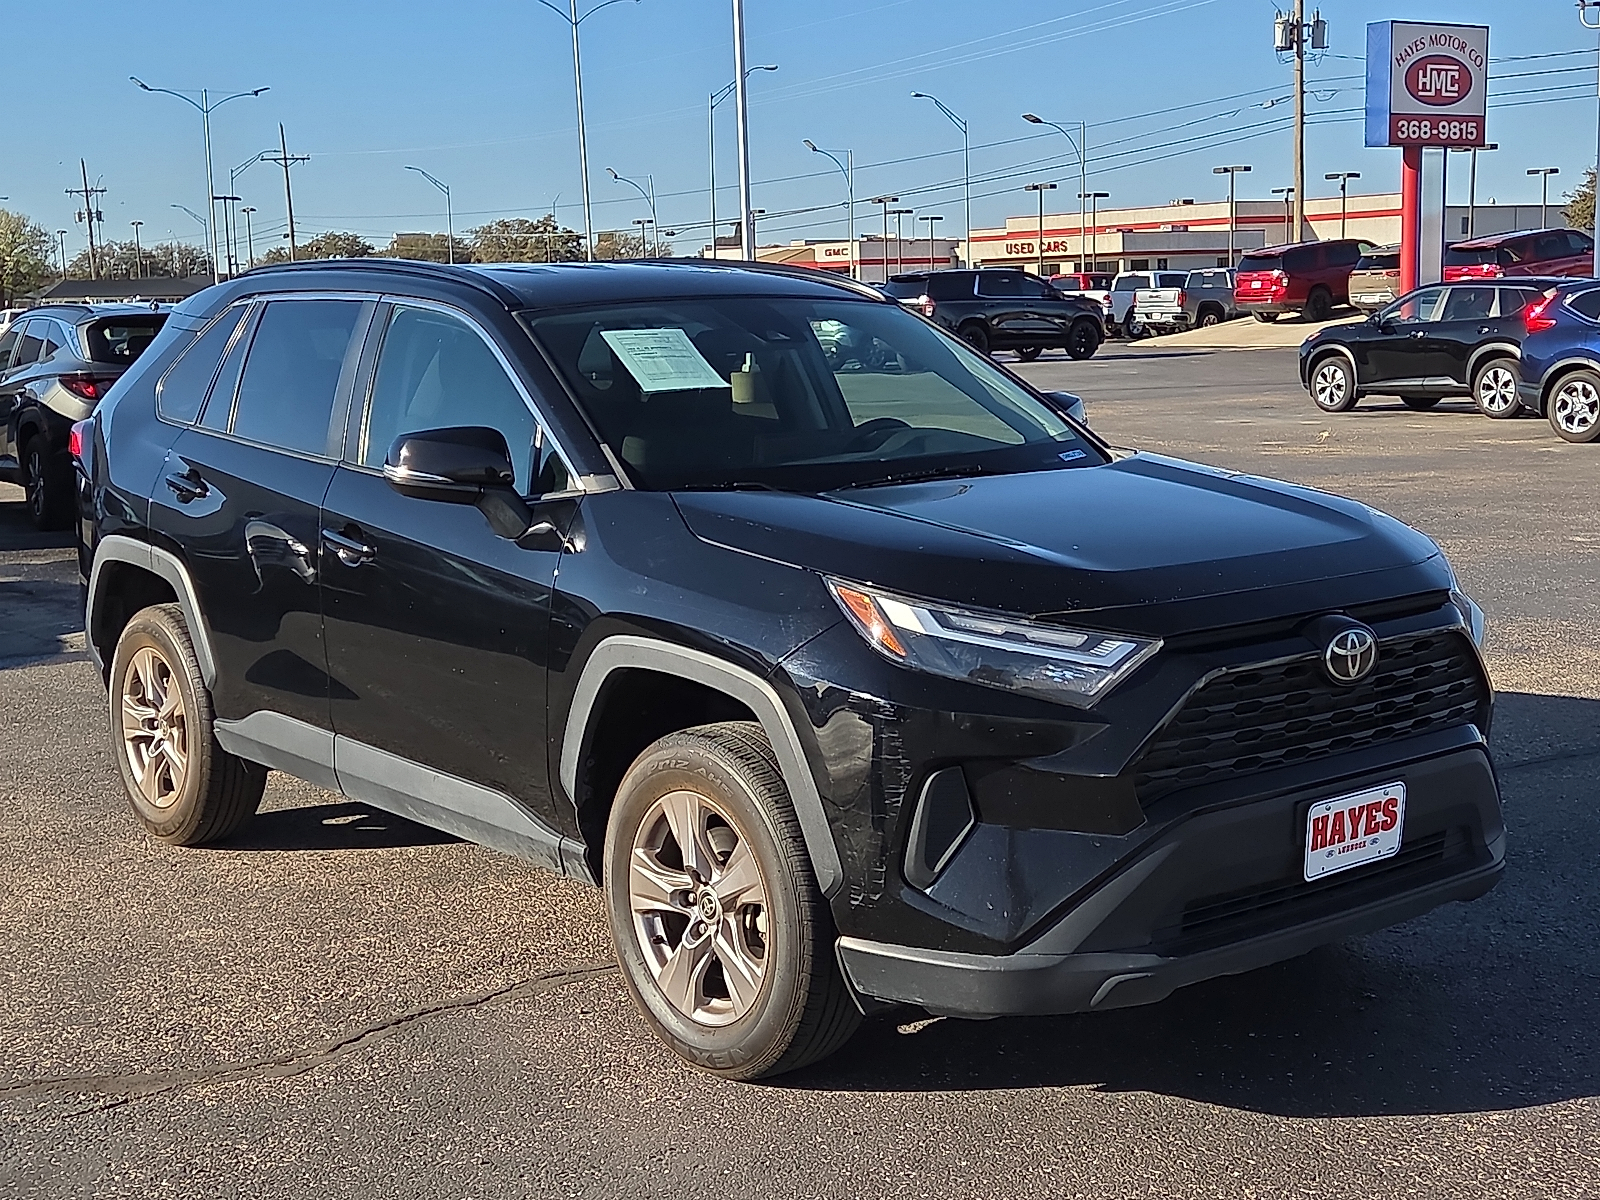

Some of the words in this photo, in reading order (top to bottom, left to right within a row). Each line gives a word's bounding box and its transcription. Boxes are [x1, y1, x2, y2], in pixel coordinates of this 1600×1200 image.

[1395, 36, 1426, 68] HAYES
[1429, 33, 1467, 54] MOTOR
[1468, 48, 1484, 71] CO.
[1418, 64, 1459, 97] HMC
[1397, 120, 1477, 140] 368-9815
[824, 247, 849, 257] GMC
[1005, 242, 1034, 255] USED
[1039, 240, 1068, 253] CARS
[1310, 797, 1399, 852] HAYES
